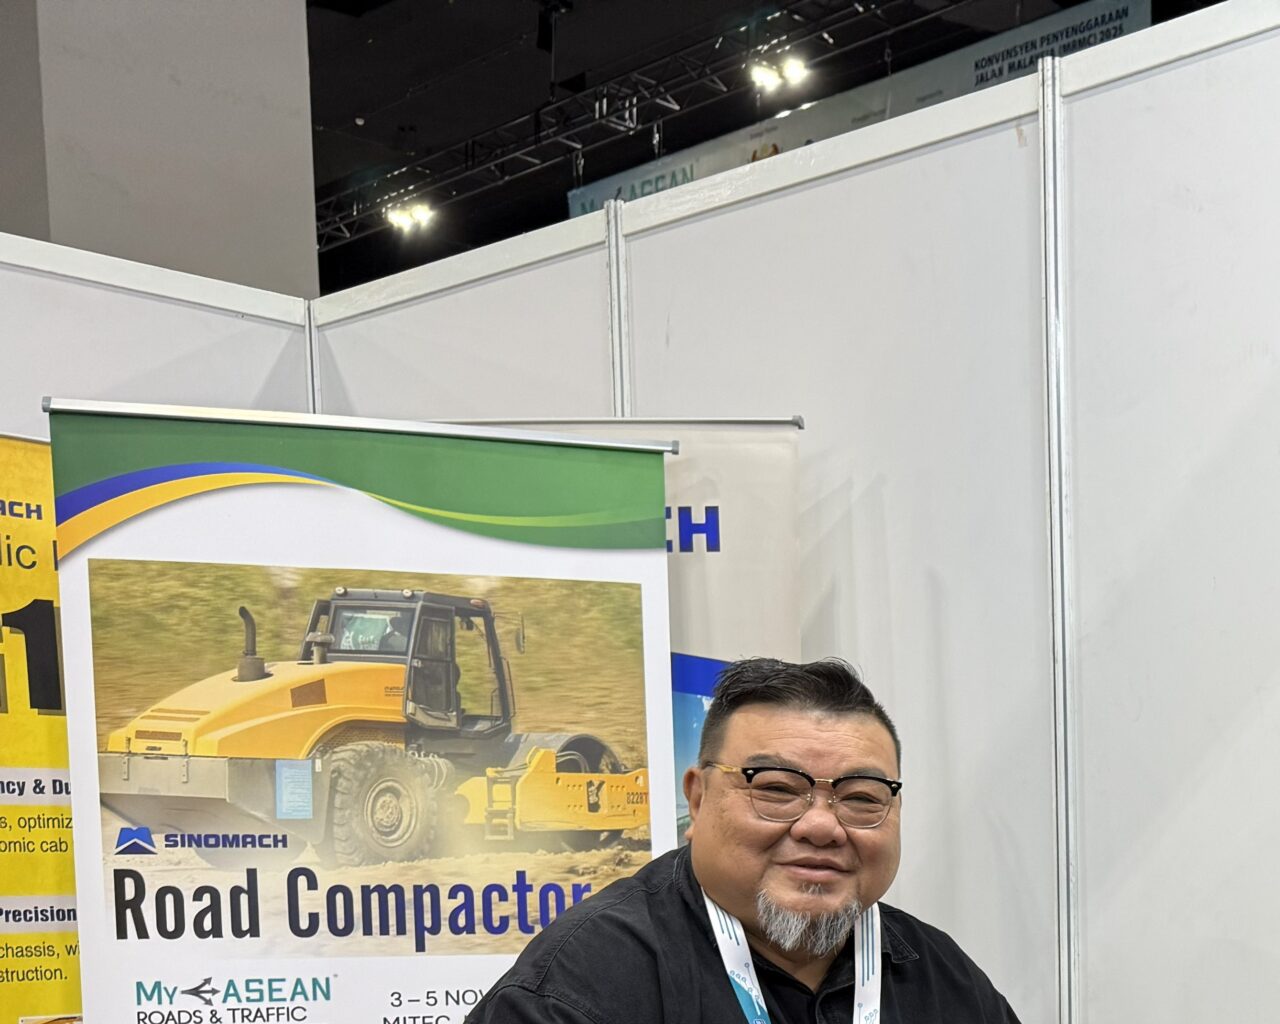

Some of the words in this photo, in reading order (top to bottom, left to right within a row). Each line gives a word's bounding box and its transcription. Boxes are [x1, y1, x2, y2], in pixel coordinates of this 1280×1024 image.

[0, 501, 43, 520] CH
[33, 779, 45, 795] &
[40, 838, 68, 853] cab
[164, 833, 288, 849] SINOMACH
[113, 868, 261, 940] Road
[222, 977, 331, 1003] ASEAN
[390, 991, 402, 1007] 3
[426, 990, 438, 1006] 5
[209, 1009, 222, 1024] &
[227, 1006, 307, 1024] TRAFFIC
